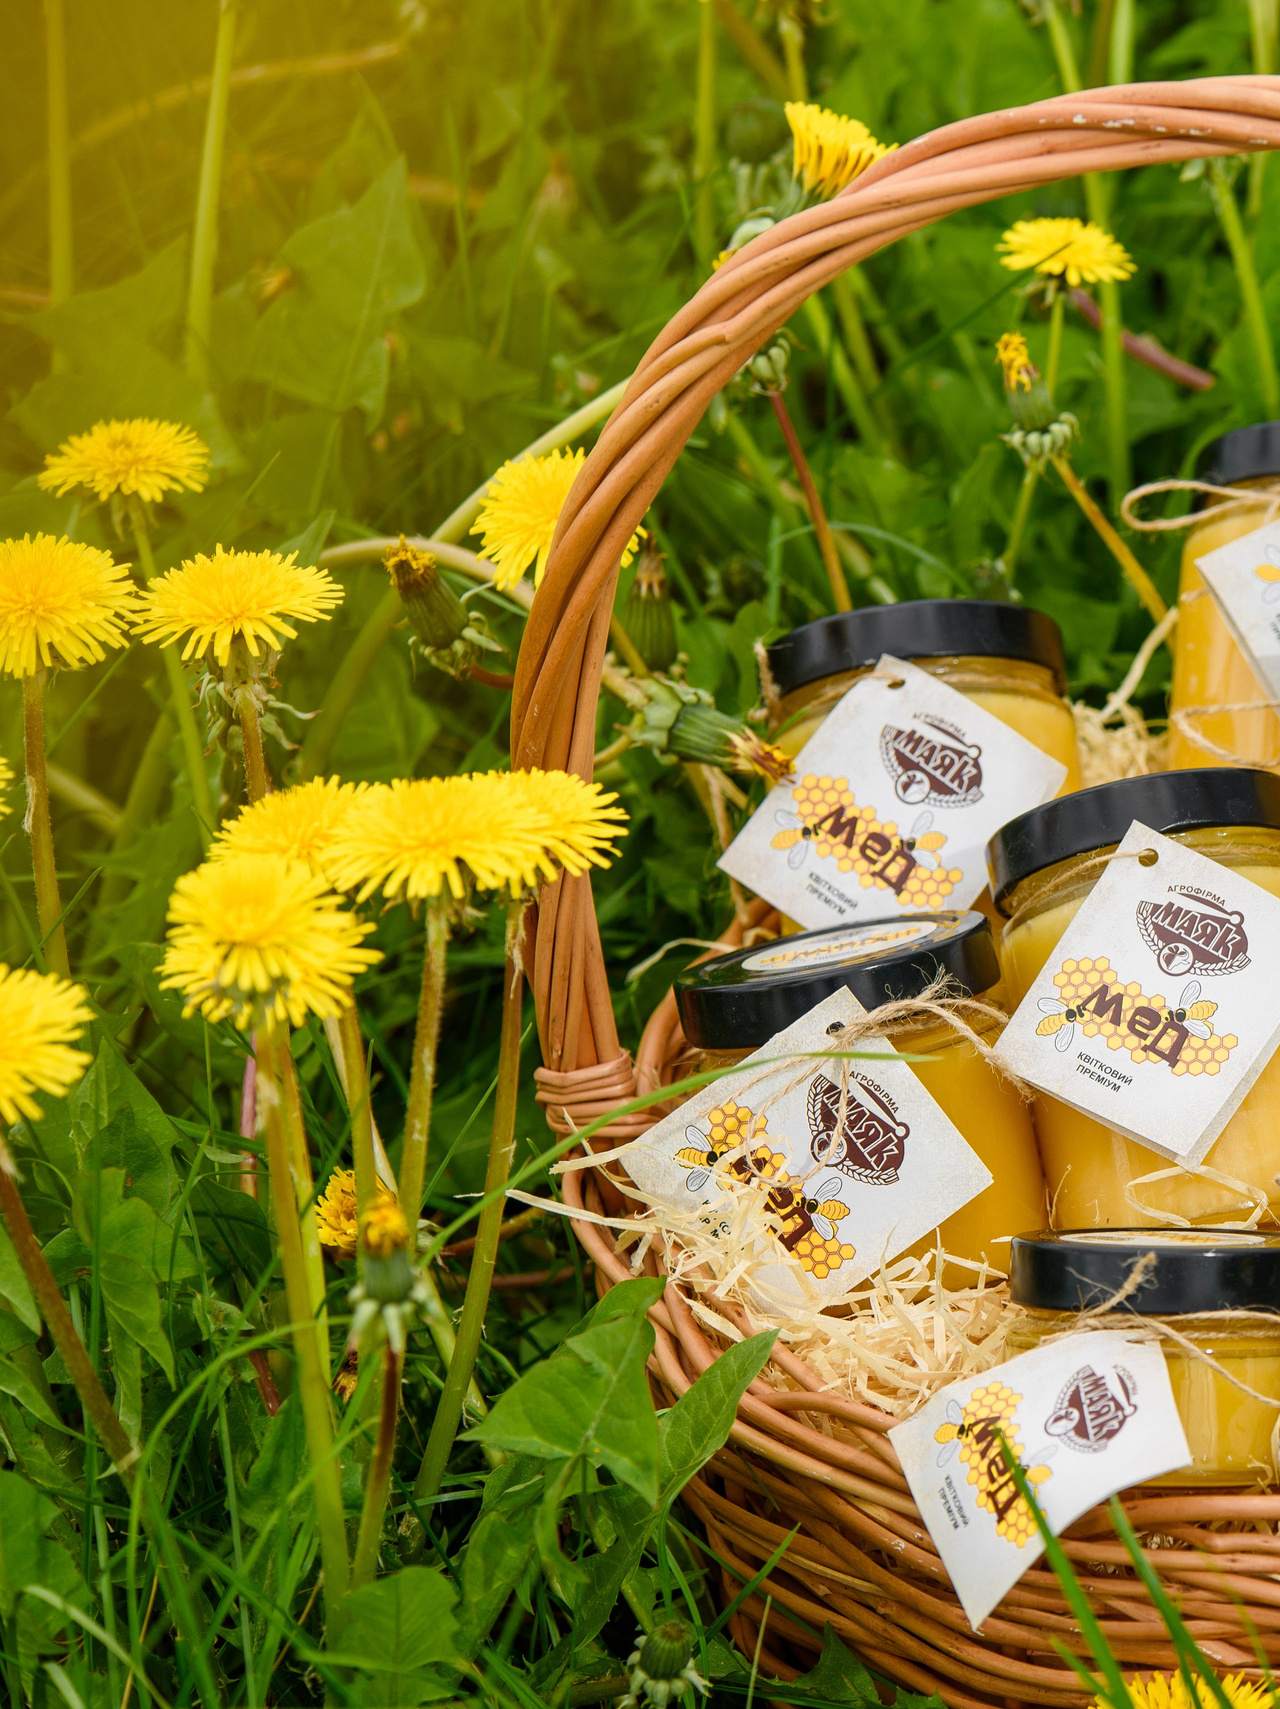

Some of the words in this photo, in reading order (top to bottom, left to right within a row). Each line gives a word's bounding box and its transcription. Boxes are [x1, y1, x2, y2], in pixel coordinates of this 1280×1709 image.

[912, 712, 967, 738] АГРОФІРМА
[895, 729, 979, 794] МАЯК
[806, 883, 846, 916] ПРЕМІУМ
[808, 872, 858, 909] КВІТКОВИЙ
[1167, 884, 1226, 907] АГРОФІРМА
[1152, 901, 1242, 959] МАЯК
[1075, 1064, 1121, 1092] ПРЕМІУМ
[1077, 1051, 1133, 1085] КВІТКОВИЙ
[849, 1070, 900, 1113] АГРОФІРМА
[823, 1085, 901, 1172] МАЯК
[1080, 1374, 1123, 1444] МАЯК
[937, 1487, 959, 1531] ПРЕМІУМ
[945, 1474, 969, 1528] КВІТКОВИЙ
